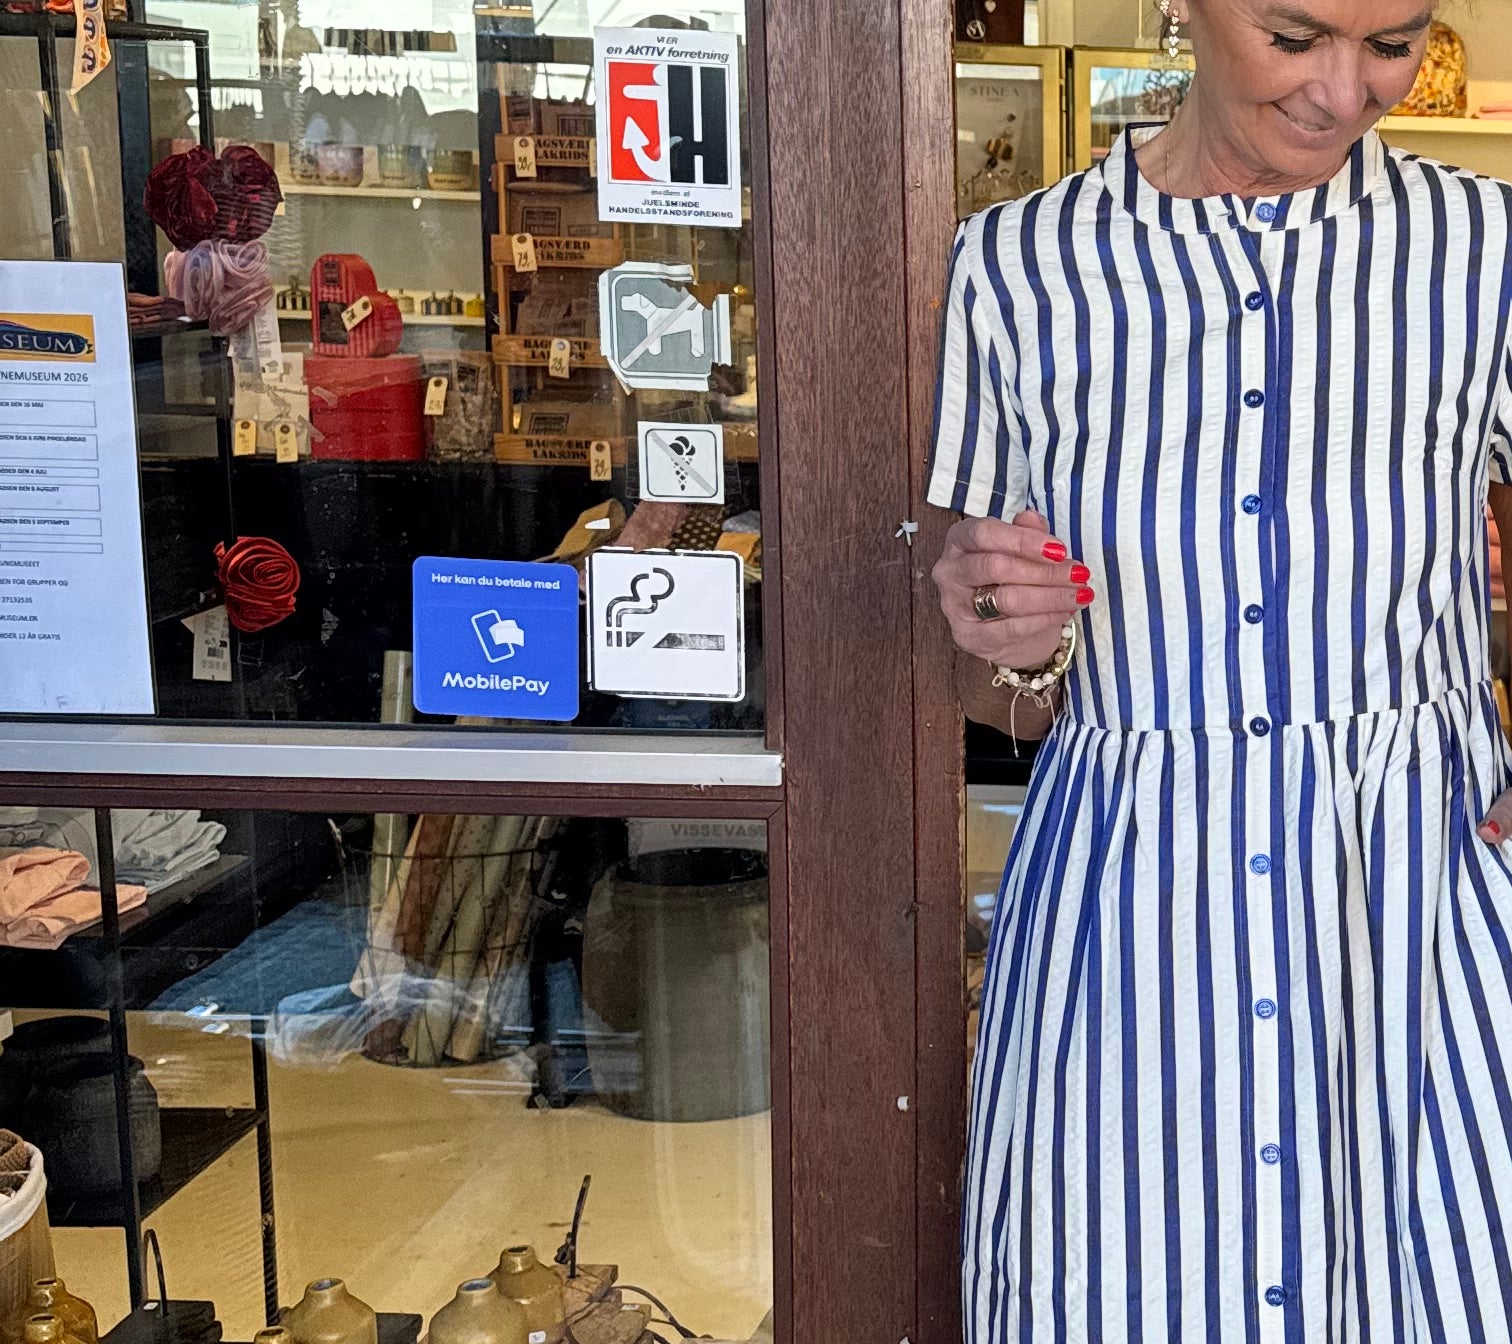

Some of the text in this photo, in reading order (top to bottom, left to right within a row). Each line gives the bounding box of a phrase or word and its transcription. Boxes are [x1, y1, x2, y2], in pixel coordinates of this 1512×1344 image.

[606, 45, 729, 63] en AKTIV forretning
[641, 199, 700, 209] JUELSMINDE
[608, 206, 734, 219] HANDELSSTANDSFORENING
[64, 372, 89, 383] 2026
[431, 572, 560, 590] Her kan du betale med
[442, 671, 550, 696] MobilePay
